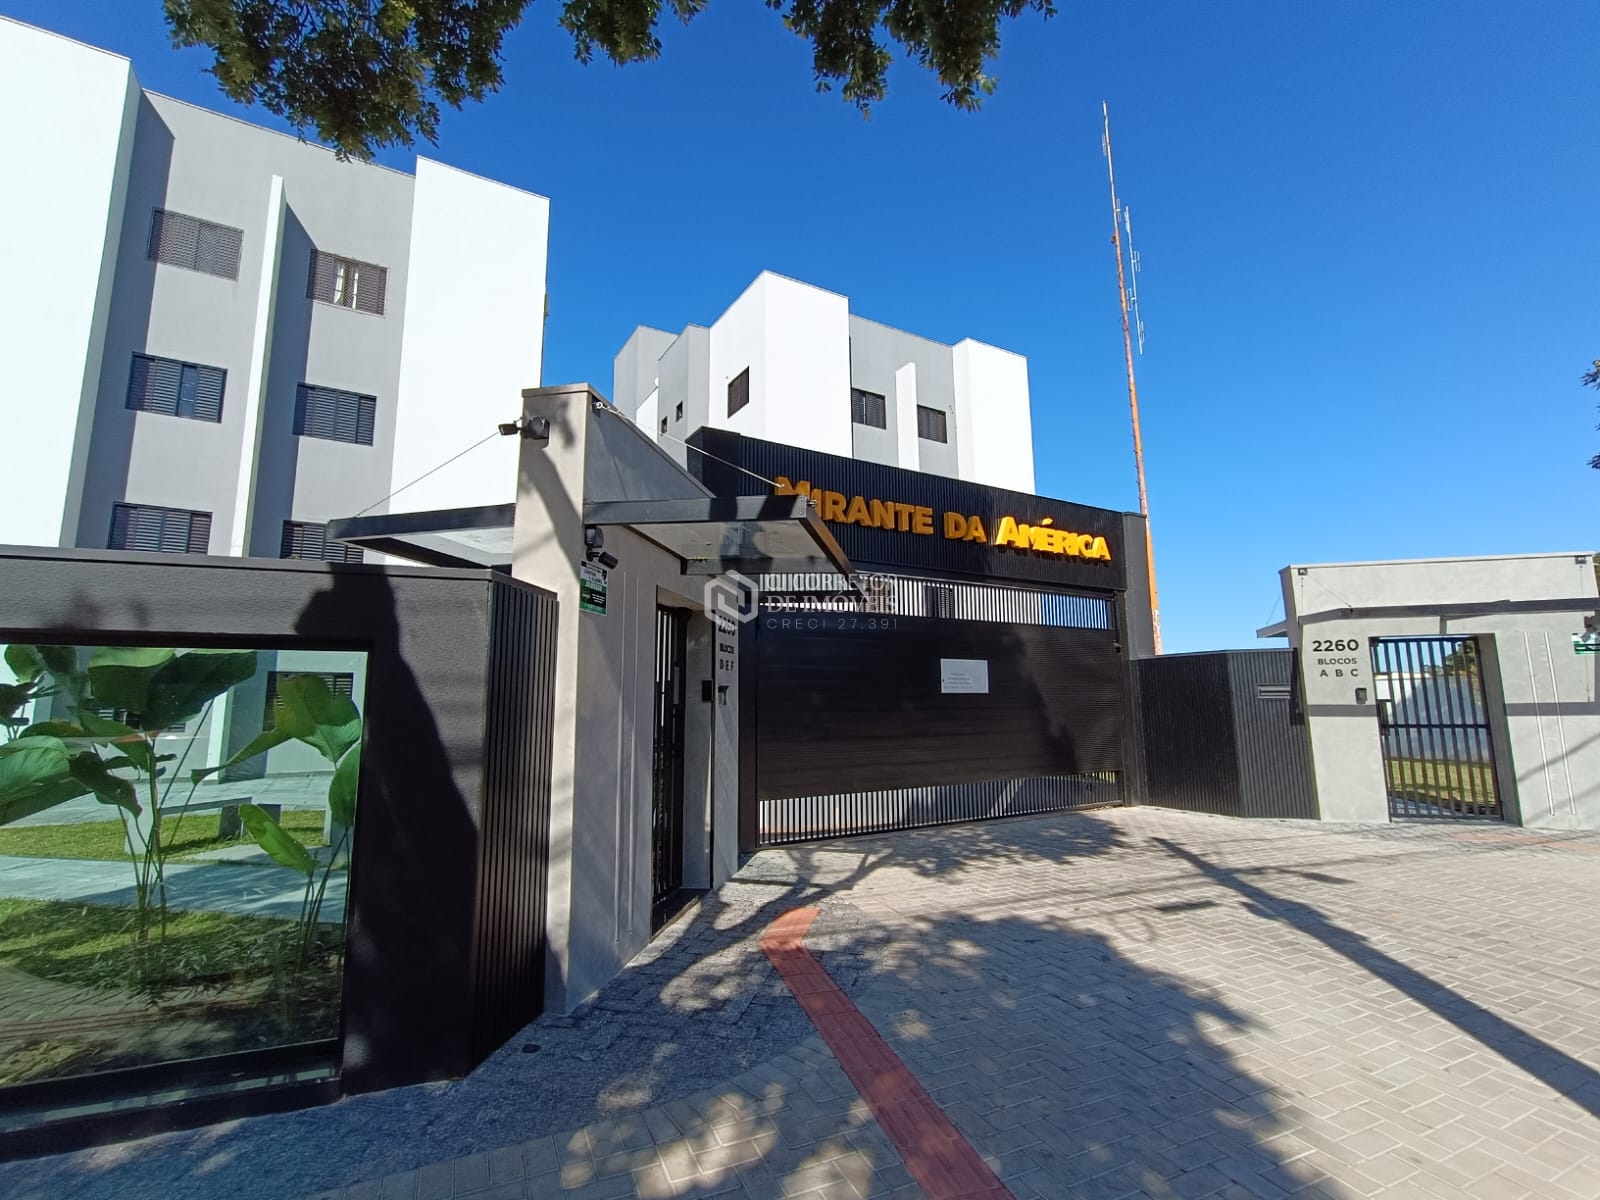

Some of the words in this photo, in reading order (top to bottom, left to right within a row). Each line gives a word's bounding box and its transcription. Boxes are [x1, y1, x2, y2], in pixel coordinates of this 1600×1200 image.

[774, 476, 934, 535] MIRANTE
[944, 511, 987, 543] DA
[995, 516, 1112, 560] AMÉRICA
[1312, 639, 1359, 652] 2260
[1317, 657, 1358, 665] BLOCOS
[1320, 669, 1329, 677] A
[1335, 669, 1344, 677] B
[1350, 668, 1359, 677] C
